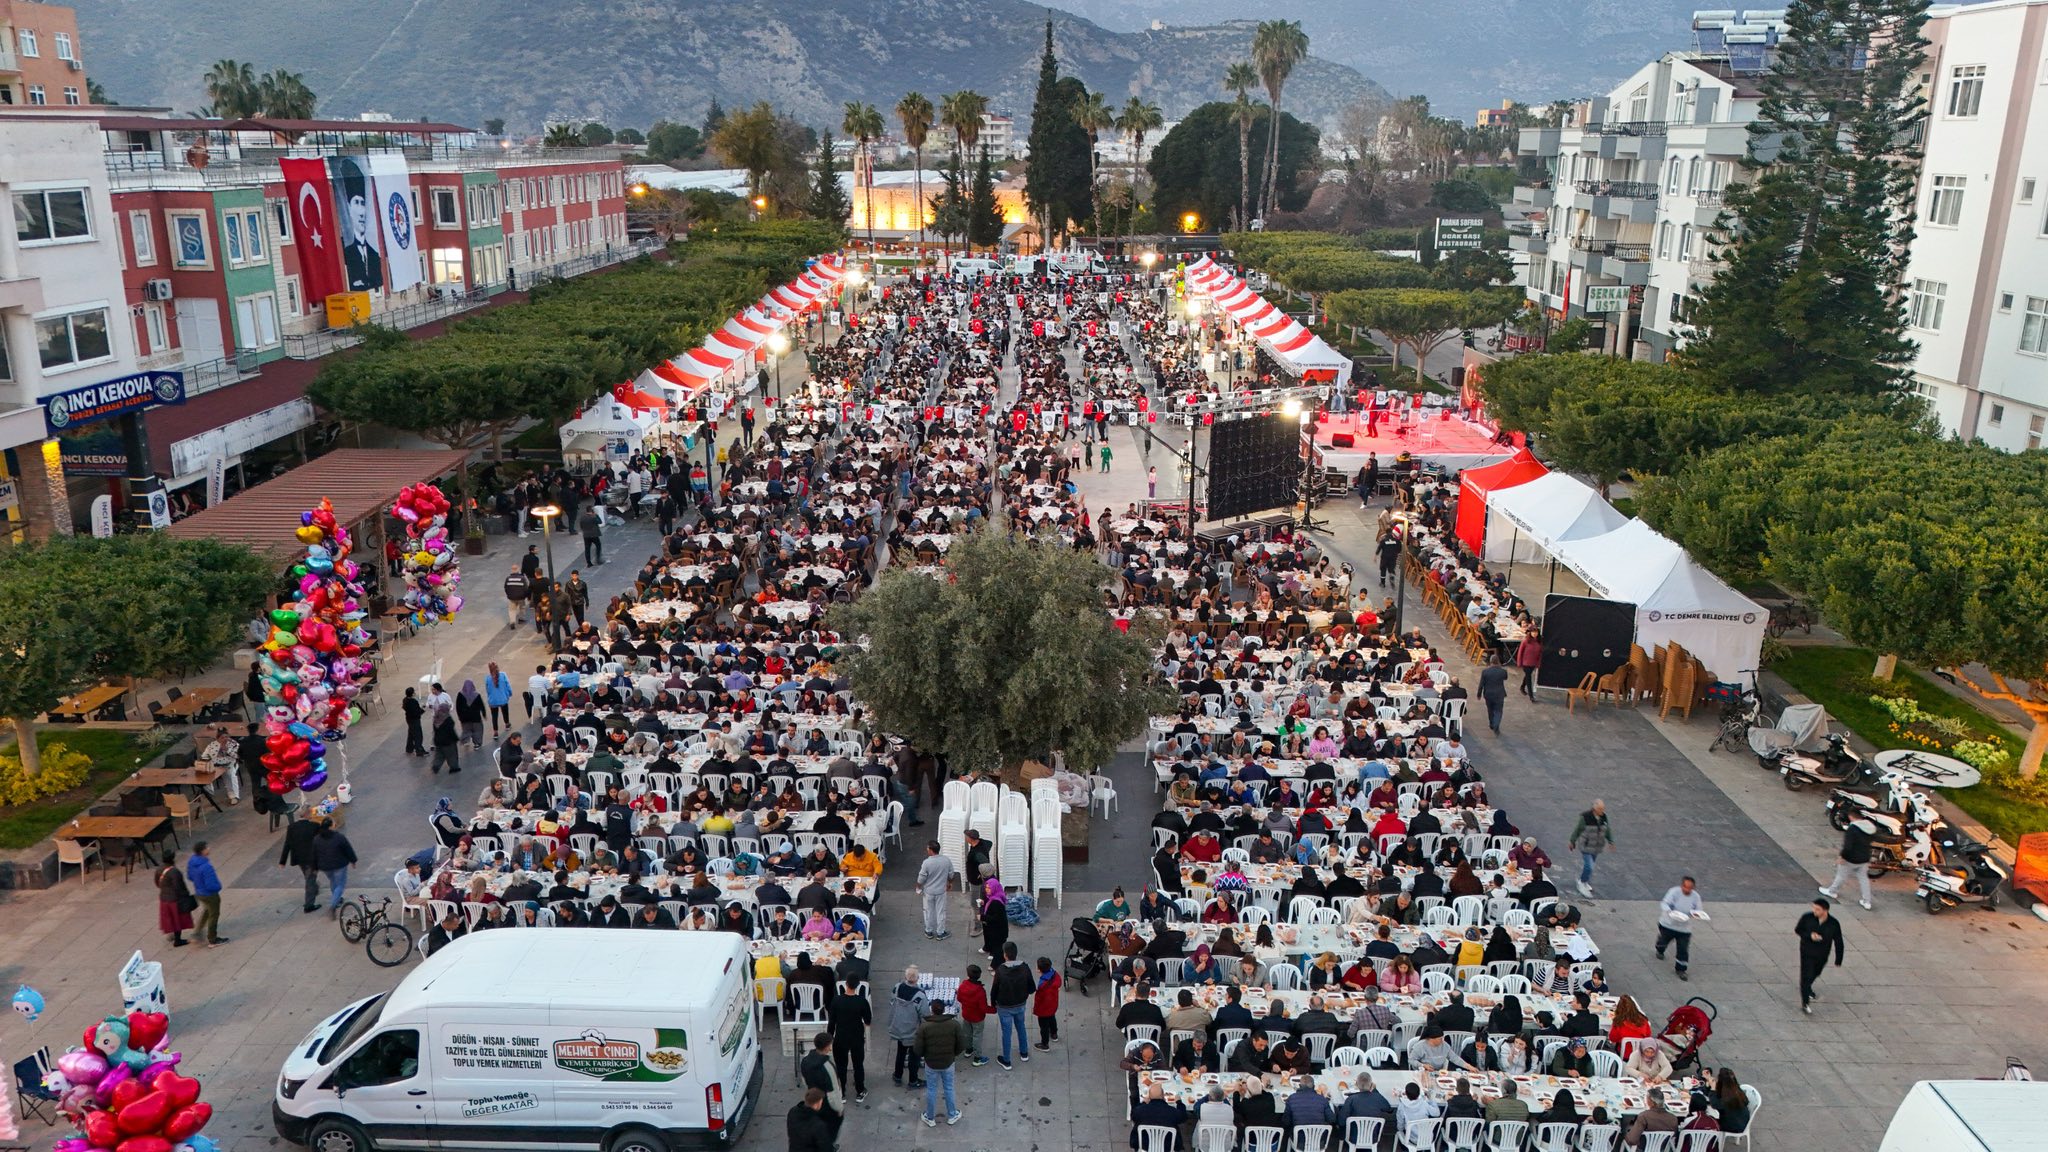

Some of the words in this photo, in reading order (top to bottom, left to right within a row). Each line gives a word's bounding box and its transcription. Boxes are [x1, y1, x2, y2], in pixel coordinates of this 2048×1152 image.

[1590, 288, 1630, 299] SERKAN
[1596, 300, 1620, 311] USTA
[98, 376, 153, 404] KEKOVA
[84, 455, 128, 464] KEKOVA
[1702, 613, 1740, 621] BELEDİYESİ
[452, 1034, 476, 1044] DÜĞÜN
[483, 1034, 505, 1046] NİŞAN
[512, 1036, 540, 1046] SÜNNET
[445, 1046, 467, 1056] TAZİYE
[480, 1046, 496, 1056] ÖZEL
[498, 1047, 548, 1058] GÜNLERİNİZDE
[558, 1045, 599, 1057] MEHMET
[604, 1046, 635, 1058] ÇINAR
[453, 1058, 475, 1067] TOPLU
[476, 1059, 500, 1068] YEMEK
[502, 1058, 542, 1069] HİZMETLERİ
[592, 1058, 632, 1067] FABRİKASI
[468, 1096, 493, 1106] Toplu
[494, 1091, 529, 1102] Yemeğe
[501, 1100, 534, 1110] KATAR
